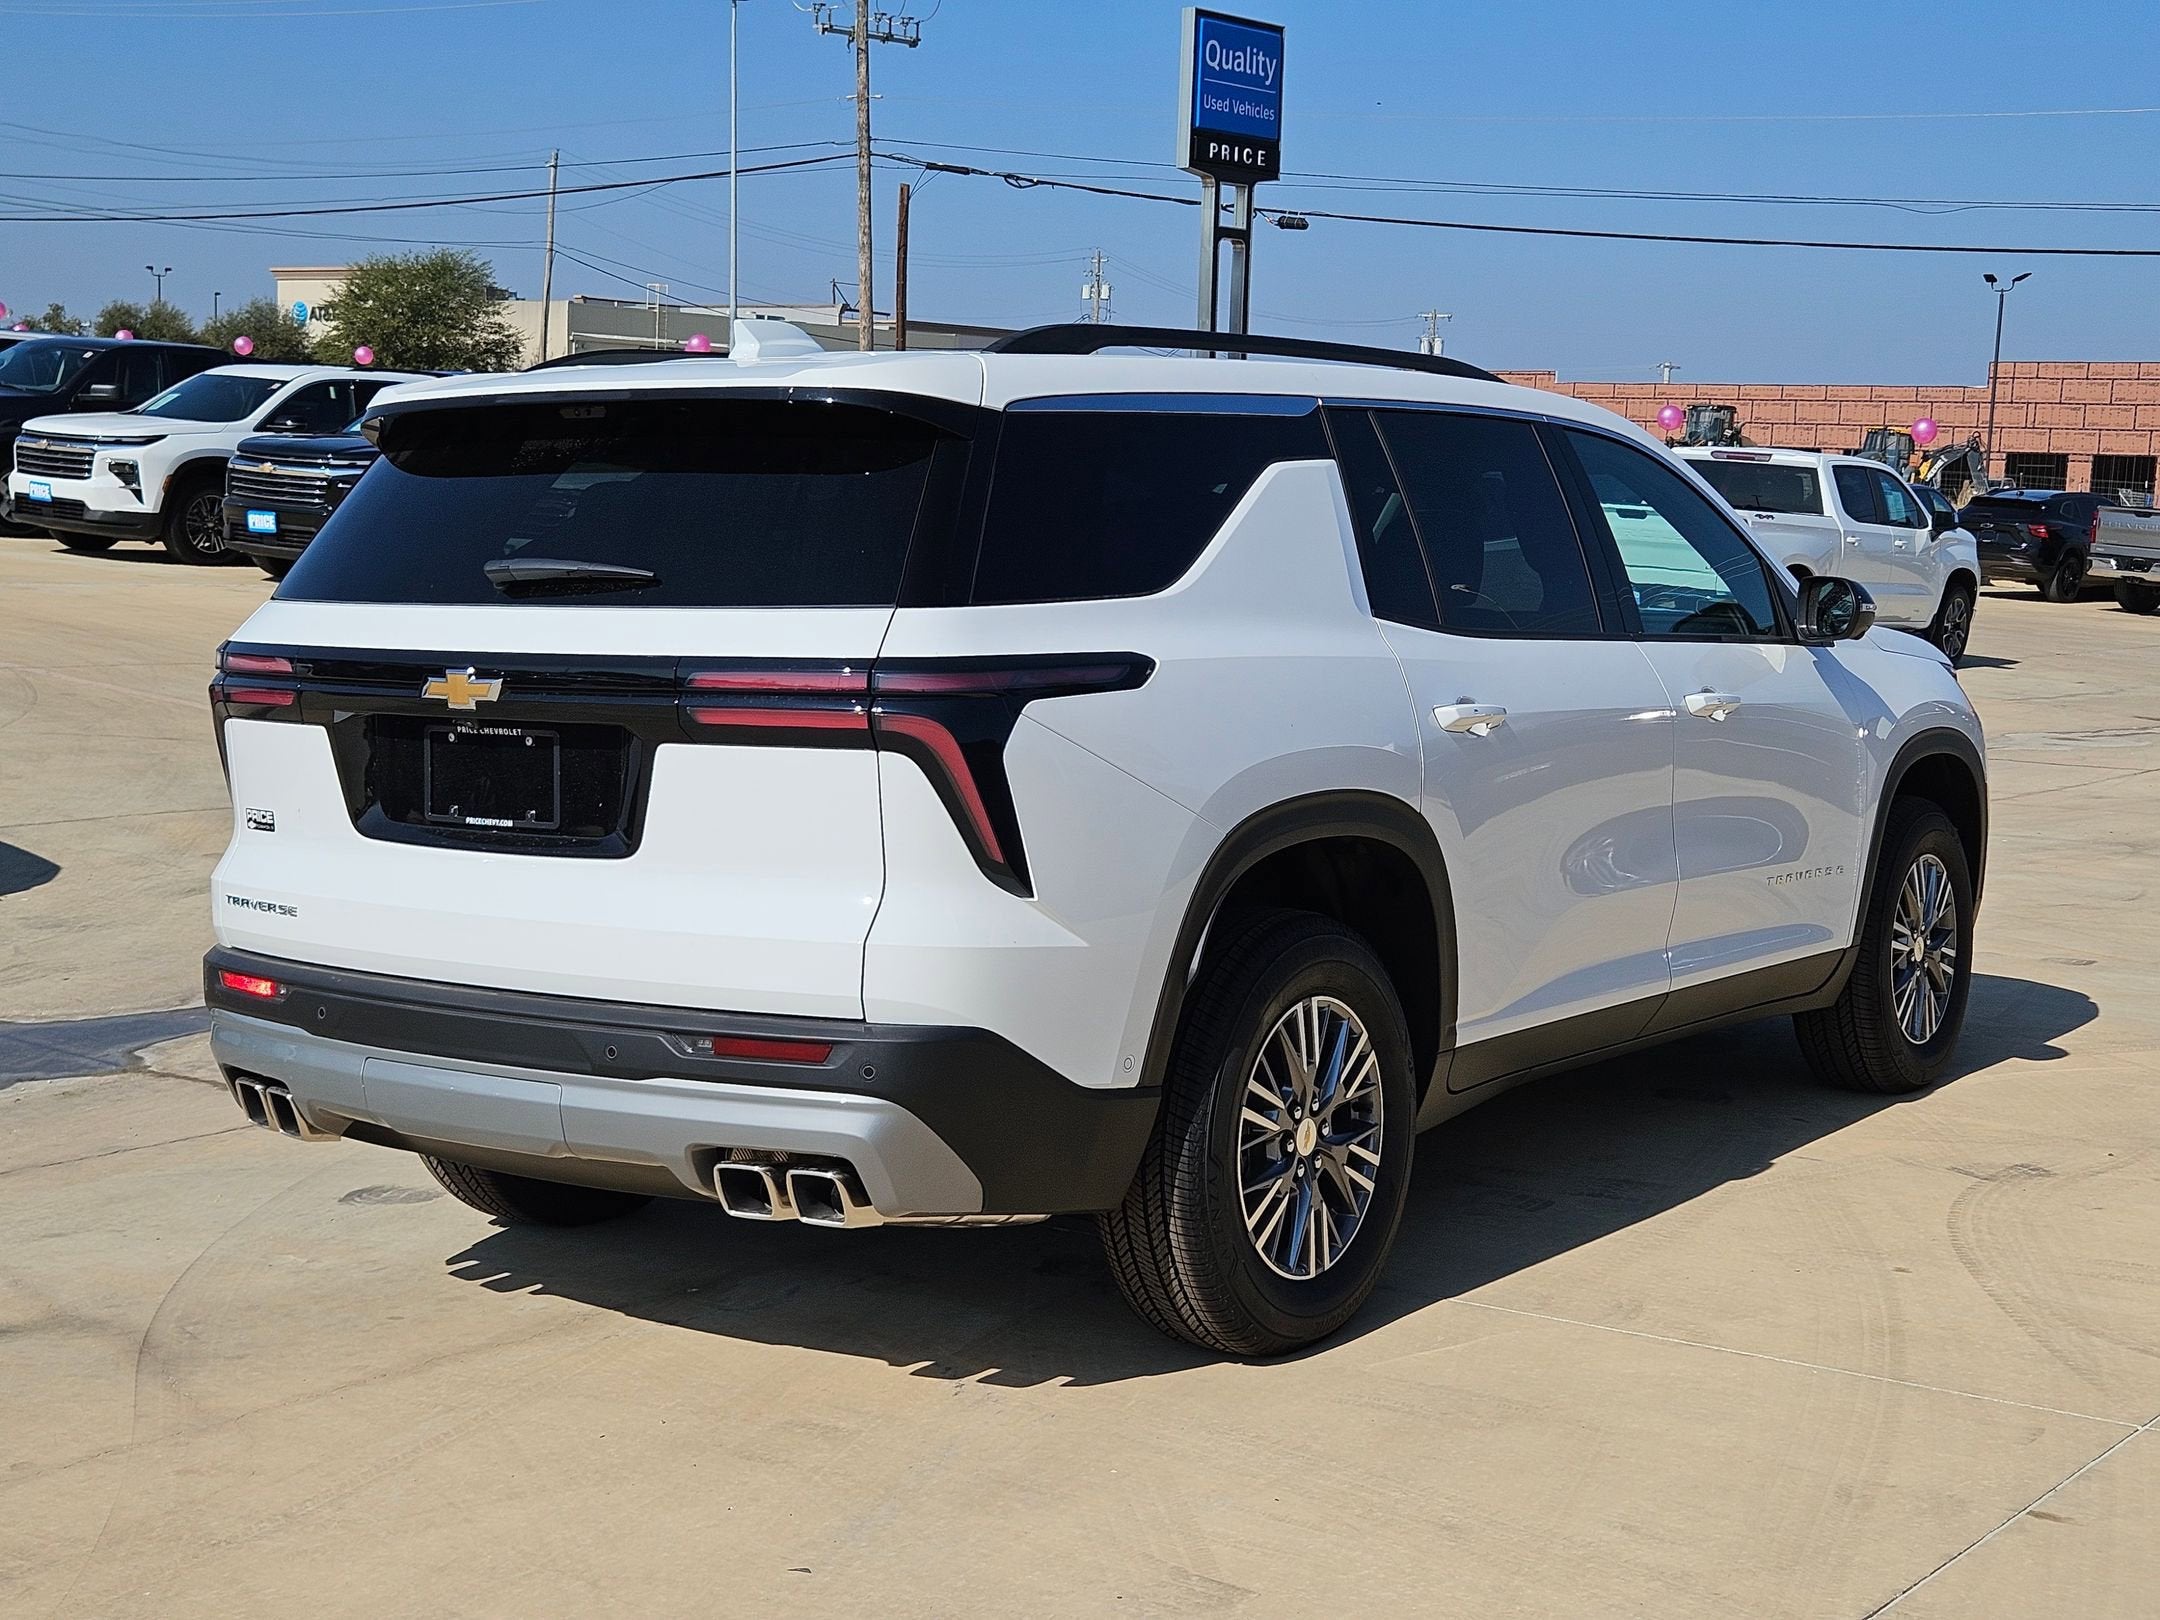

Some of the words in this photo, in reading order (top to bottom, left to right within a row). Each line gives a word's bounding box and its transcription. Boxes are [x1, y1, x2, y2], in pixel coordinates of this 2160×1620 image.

[1205, 39, 1277, 86] Quality
[1203, 94, 1230, 113] Used
[1232, 99, 1275, 121] Vehicles
[1209, 142, 1266, 166] PRICE
[309, 306, 335, 322] AT&
[248, 513, 277, 530] PRICE
[479, 727, 522, 736] CHEVROLET
[246, 809, 275, 824] PRICE
[1766, 865, 1844, 887] TRAVERSE
[225, 893, 298, 918] TRAVERSE
